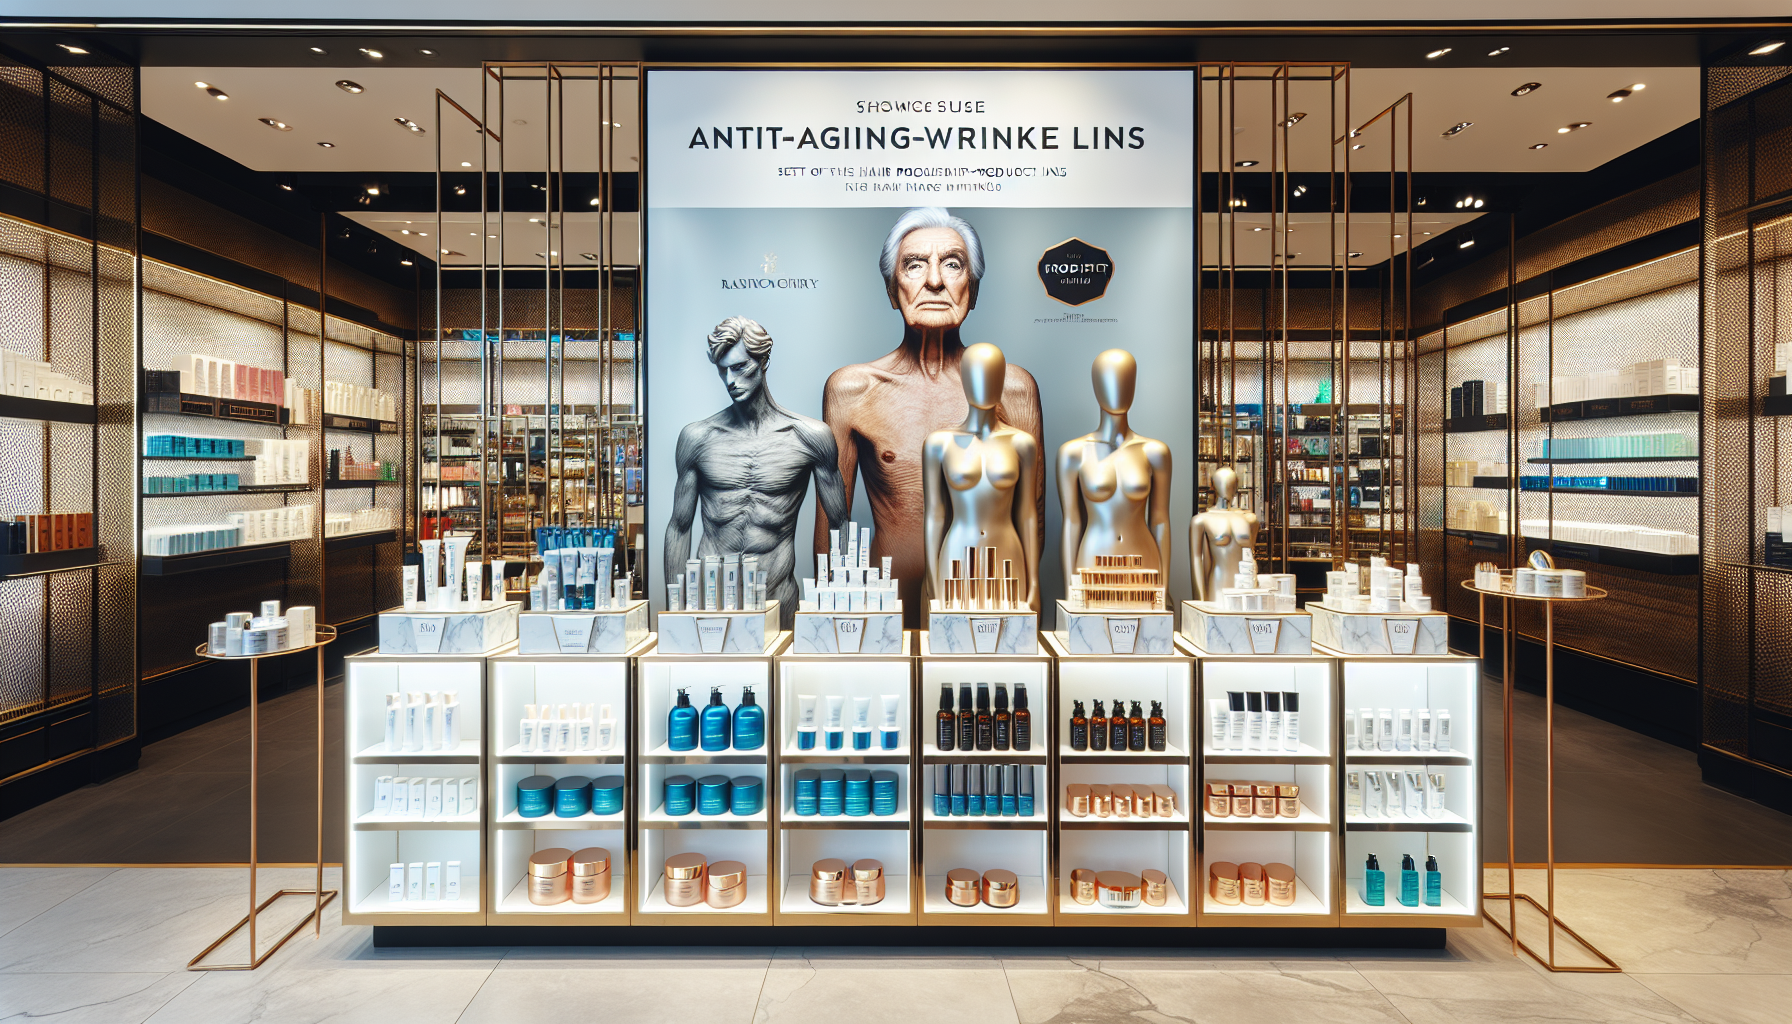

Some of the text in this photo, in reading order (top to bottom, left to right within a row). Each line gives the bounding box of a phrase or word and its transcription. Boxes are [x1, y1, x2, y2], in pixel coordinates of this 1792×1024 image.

[937, 100, 985, 113] SUSE
[688, 126, 1145, 150] ANTIT-AGIING-WRINKE LINS
